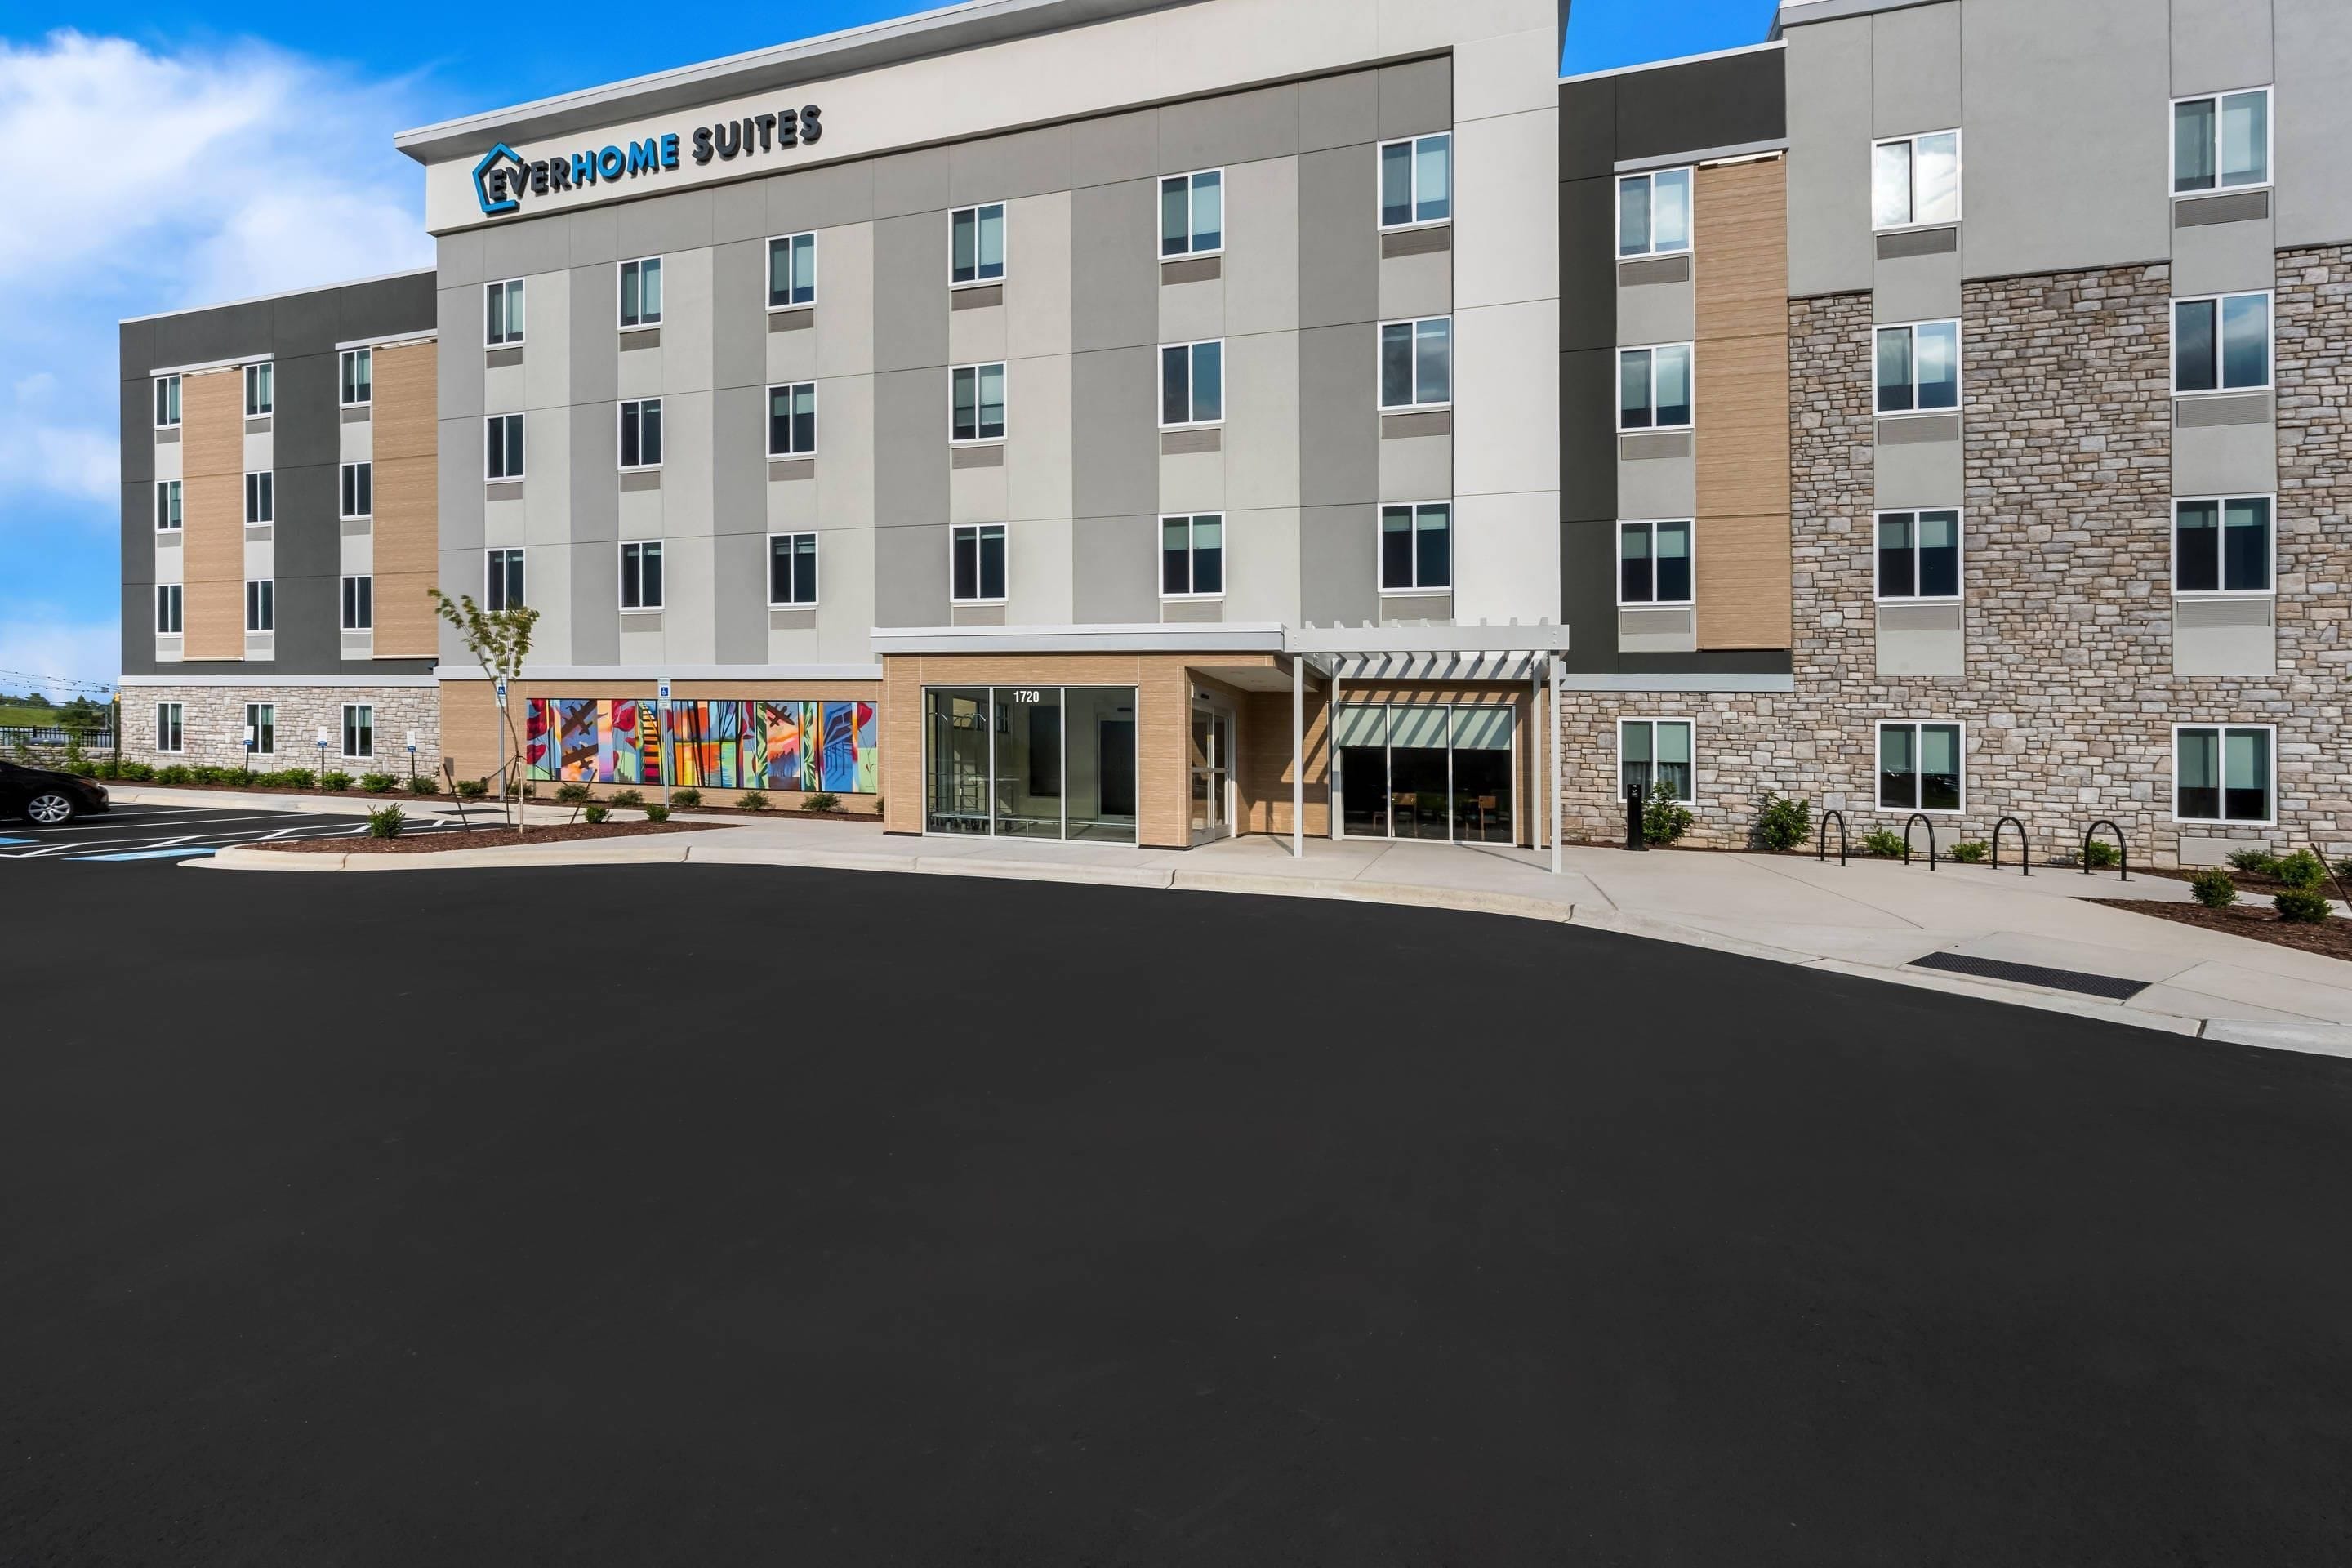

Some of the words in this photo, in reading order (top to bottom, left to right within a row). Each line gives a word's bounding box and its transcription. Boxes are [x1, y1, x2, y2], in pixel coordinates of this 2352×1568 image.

[489, 133, 679, 201] EVERHOME
[692, 105, 822, 163] SUITES
[1013, 690, 1039, 702] 1720
